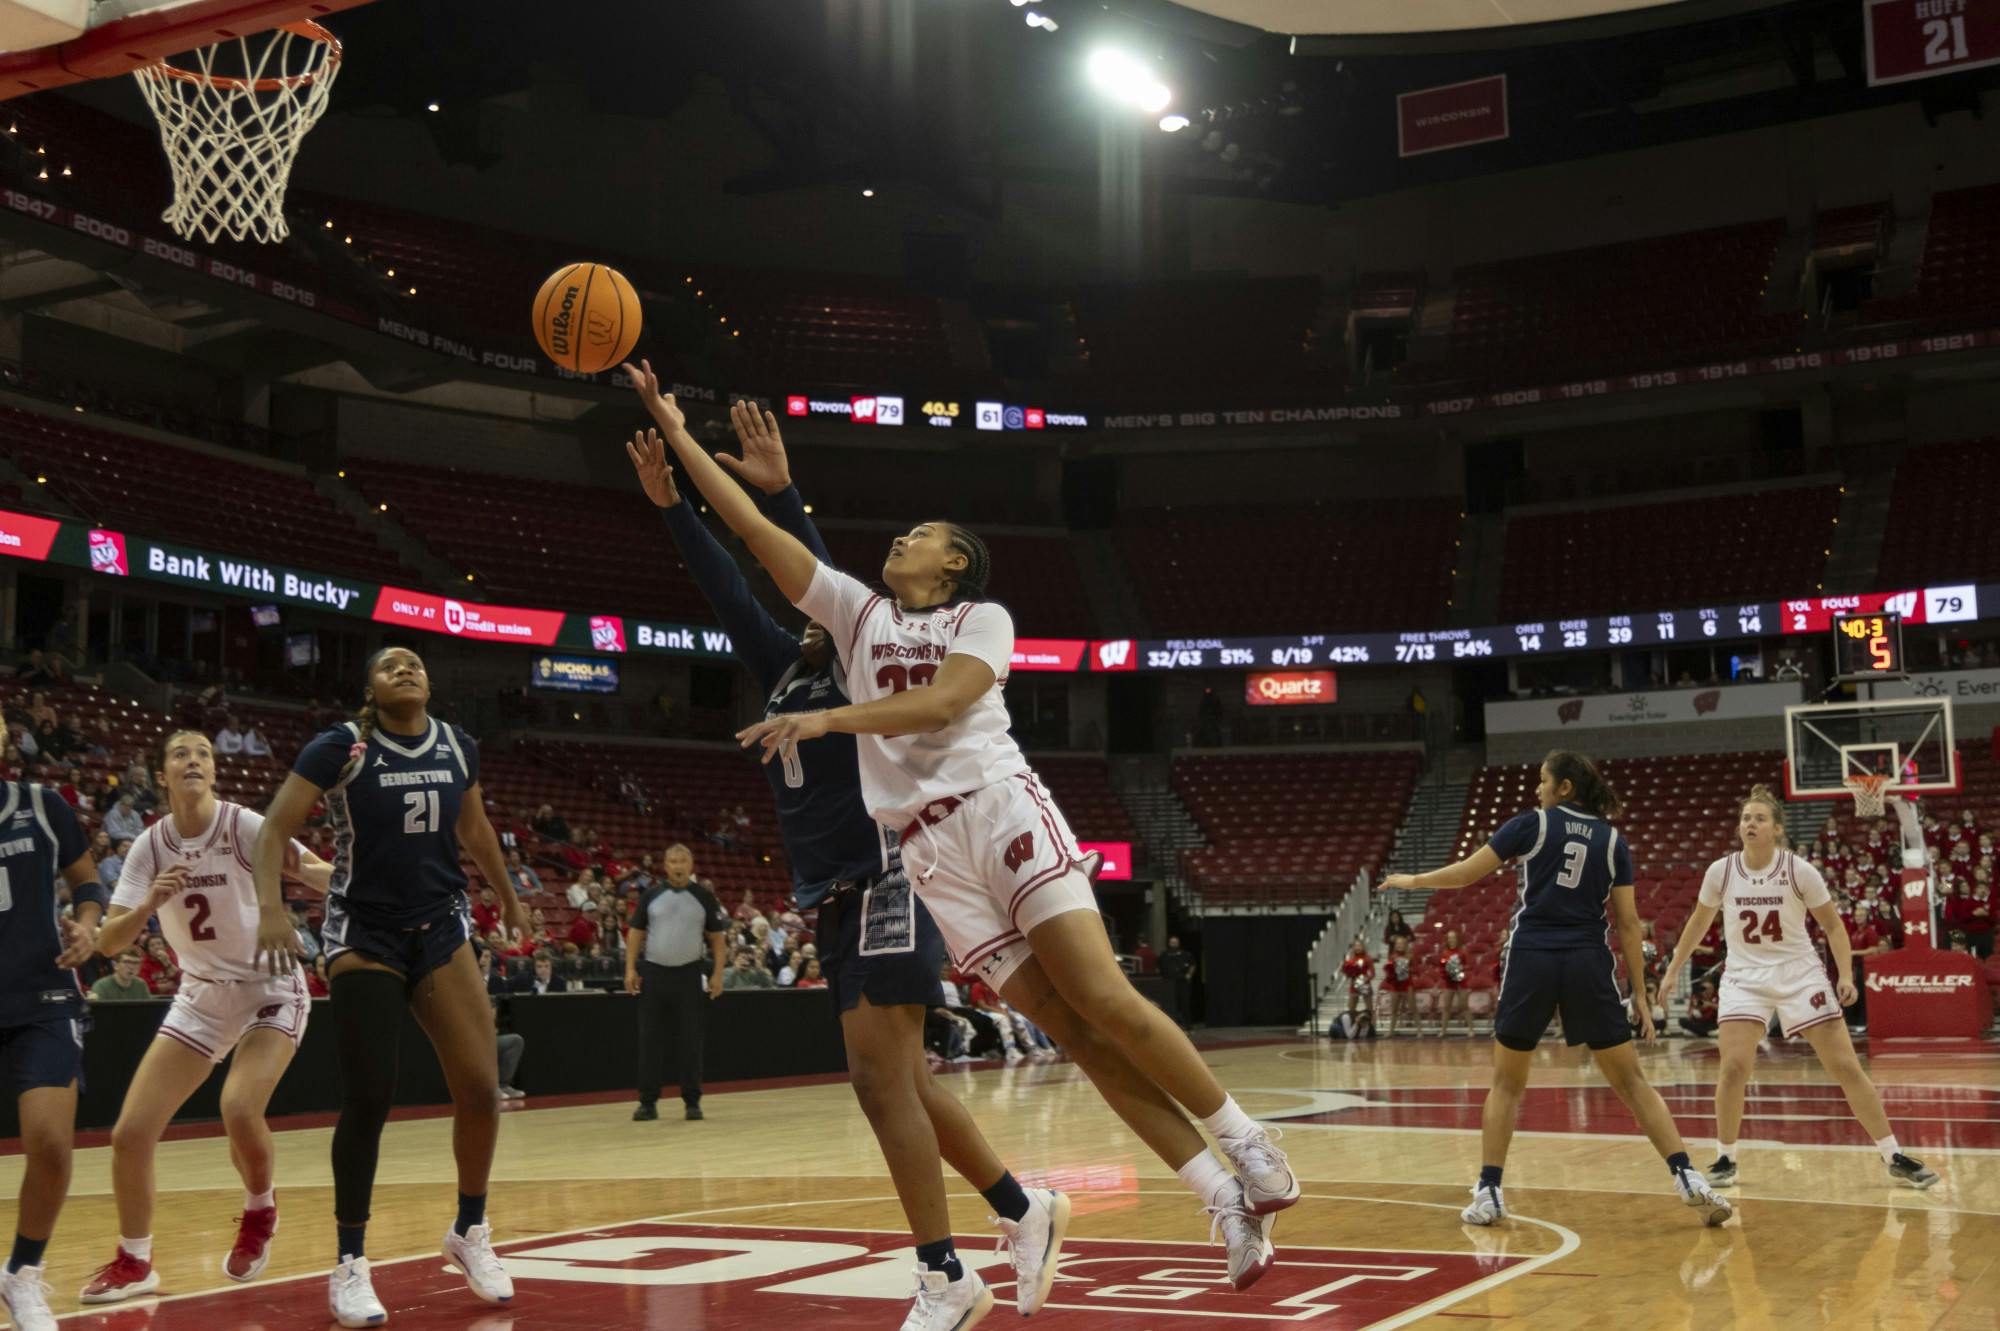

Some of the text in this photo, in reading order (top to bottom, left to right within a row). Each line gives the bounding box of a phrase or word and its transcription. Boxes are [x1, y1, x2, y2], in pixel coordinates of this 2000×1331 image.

[1922, 16, 1969, 65] 21
[1415, 106, 1491, 128] WISCONSIN
[4, 191, 315, 307] 1947 2000 2005 2014 2015
[552, 286, 579, 355] Wilson
[379, 318, 430, 346] MEN'S
[434, 336, 477, 362] FINAL
[482, 352, 537, 374] FOUR
[1426, 398, 1475, 415] 1907
[1630, 371, 1677, 389] 1913
[1698, 362, 1748, 381] 1914
[1921, 333, 1976, 353] 1921
[809, 401, 852, 414] TOYOTA
[879, 405, 900, 417] 79
[921, 401, 959, 417] 40.5
[982, 410, 1000, 422] 61
[1045, 413, 1087, 427] TOYOTA
[1104, 404, 1401, 429] MEN'S BIG TEN CHAMPIONS
[149, 547, 210, 582] Bank
[219, 560, 276, 593] With
[392, 601, 435, 619] ONLY AT
[1787, 597, 1860, 613] TOL FOULS
[1935, 597, 1963, 614] 79
[465, 620, 532, 637] credit union
[1515, 604, 1760, 635] OREB DREB REB TO STL AST
[1793, 614, 1807, 631] 2
[1841, 618, 1883, 639] 40.3
[637, 625, 695, 651] Bank
[1166, 640, 1194, 650] FIELD
[1196, 638, 1224, 649] GOAL
[1400, 629, 1471, 644] FREE THROWS
[1519, 616, 1762, 652] 14 25 39 11 6 14
[872, 643, 946, 661] WISCONSIN
[1147, 646, 1369, 669] 32/63 51% 8/19 42%
[1395, 640, 1492, 664] 7/13 54%
[1869, 636, 1891, 669] 5
[553, 662, 609, 677] NICHOLAS
[1259, 677, 1321, 699] Quartz
[379, 770, 454, 788] GEORGETOWN
[404, 790, 440, 834] 21
[1565, 821, 1593, 841] RIVERA
[1556, 841, 1588, 890] 3
[184, 873, 228, 888] CONSIN
[1734, 895, 1784, 906] WISCONSIN
[184, 893, 217, 942] 2
[1739, 910, 1784, 945] 24
[1878, 974, 1974, 987] MUELLER
